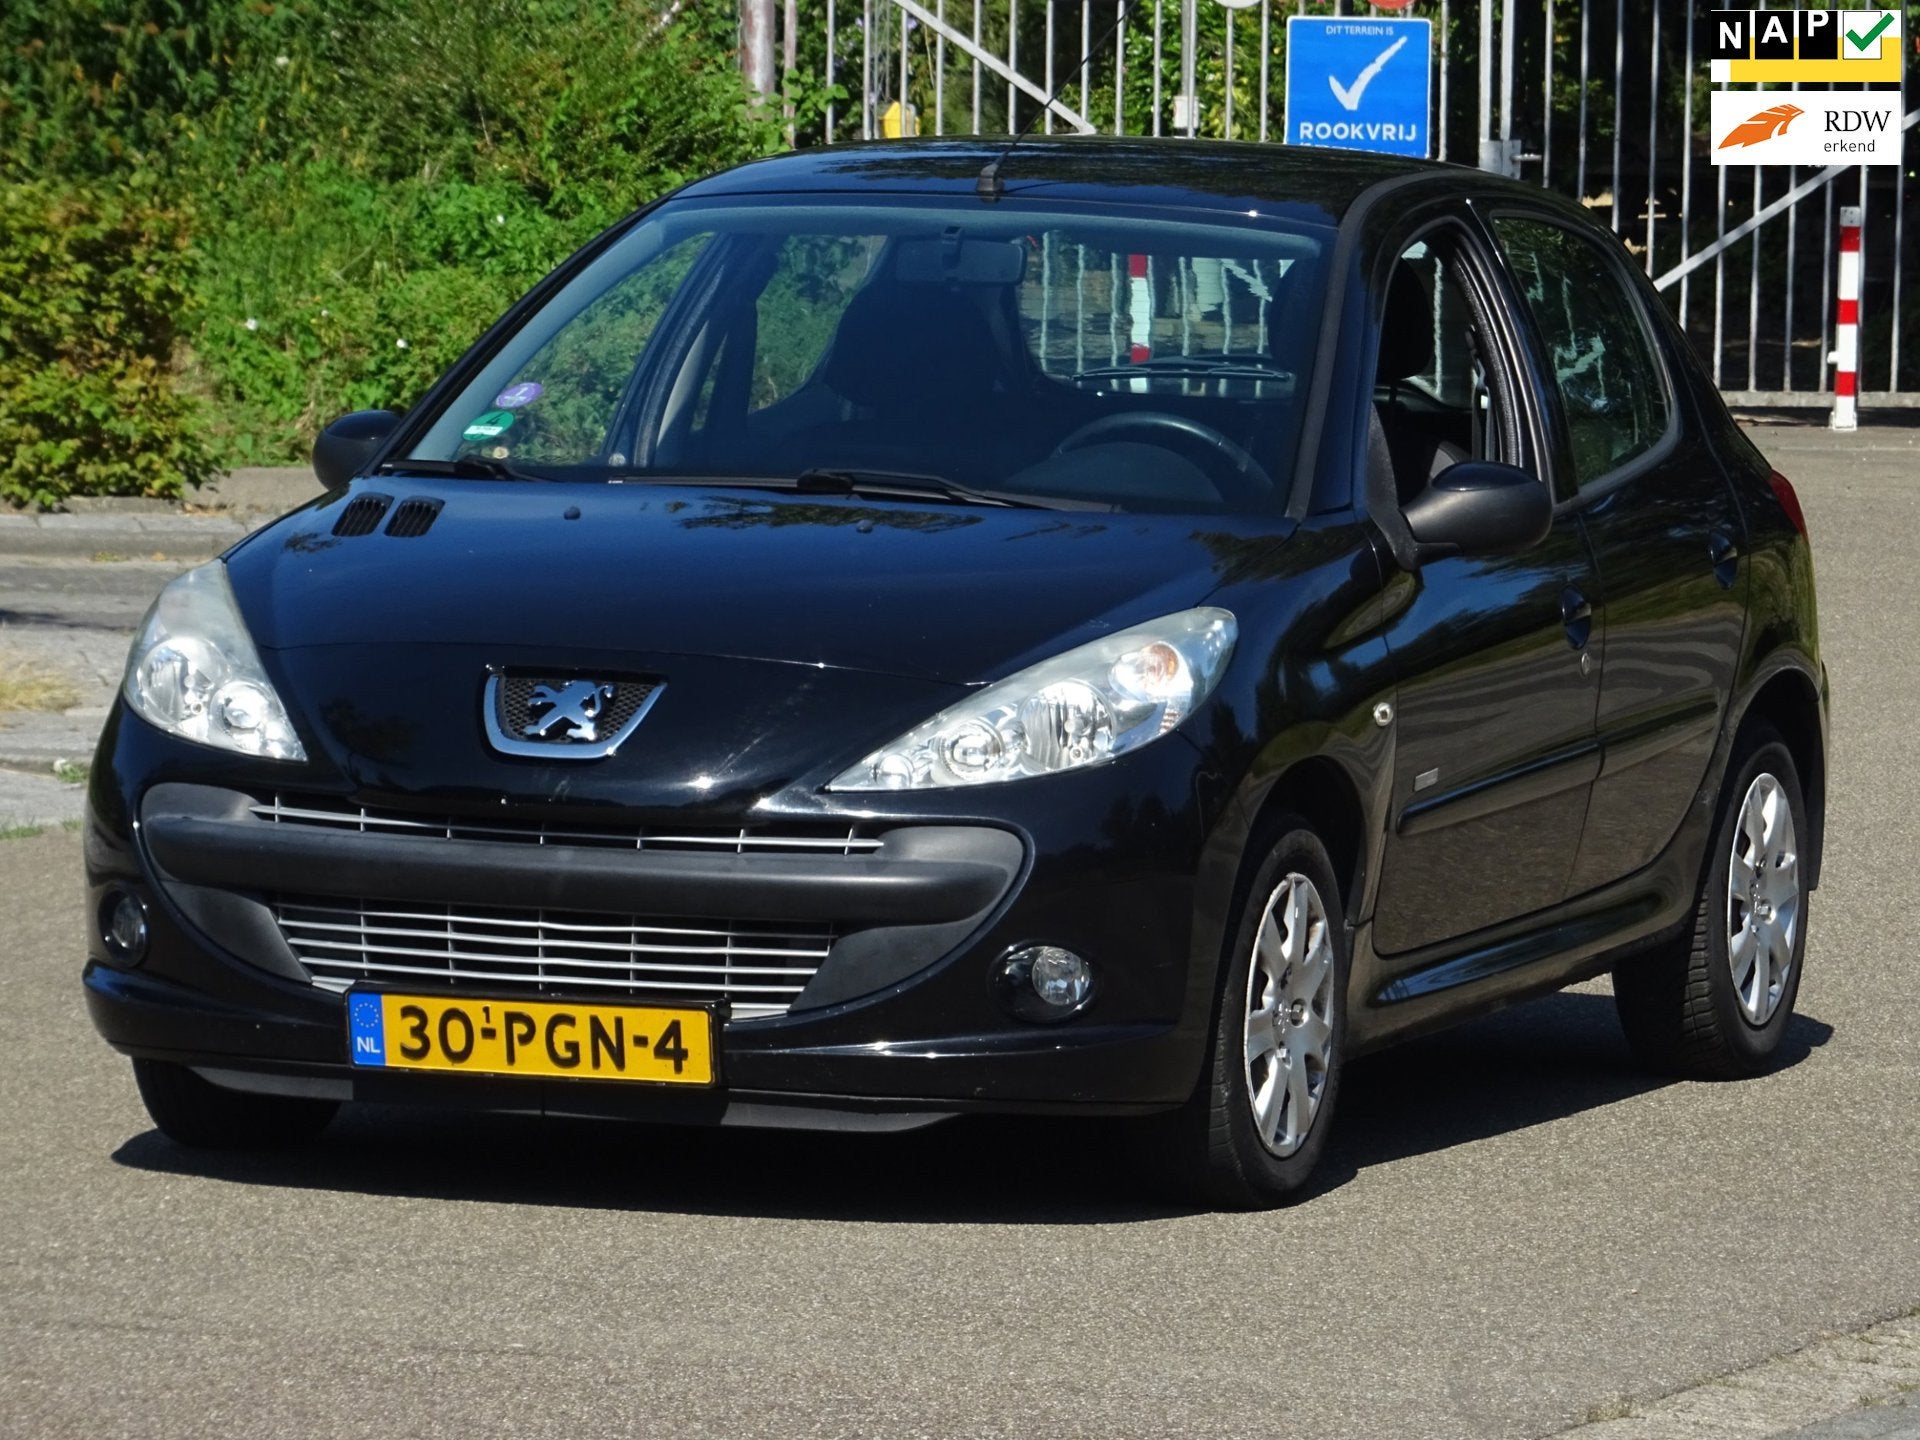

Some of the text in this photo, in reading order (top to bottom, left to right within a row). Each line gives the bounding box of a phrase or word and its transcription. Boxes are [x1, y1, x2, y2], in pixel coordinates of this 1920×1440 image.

[1326, 25, 1394, 36] DIT TERREIN IS
[1300, 122, 1417, 141] ROOKVRIJ
[356, 1036, 380, 1054] NL
[400, 1005, 689, 1074] 30-PGN-4
